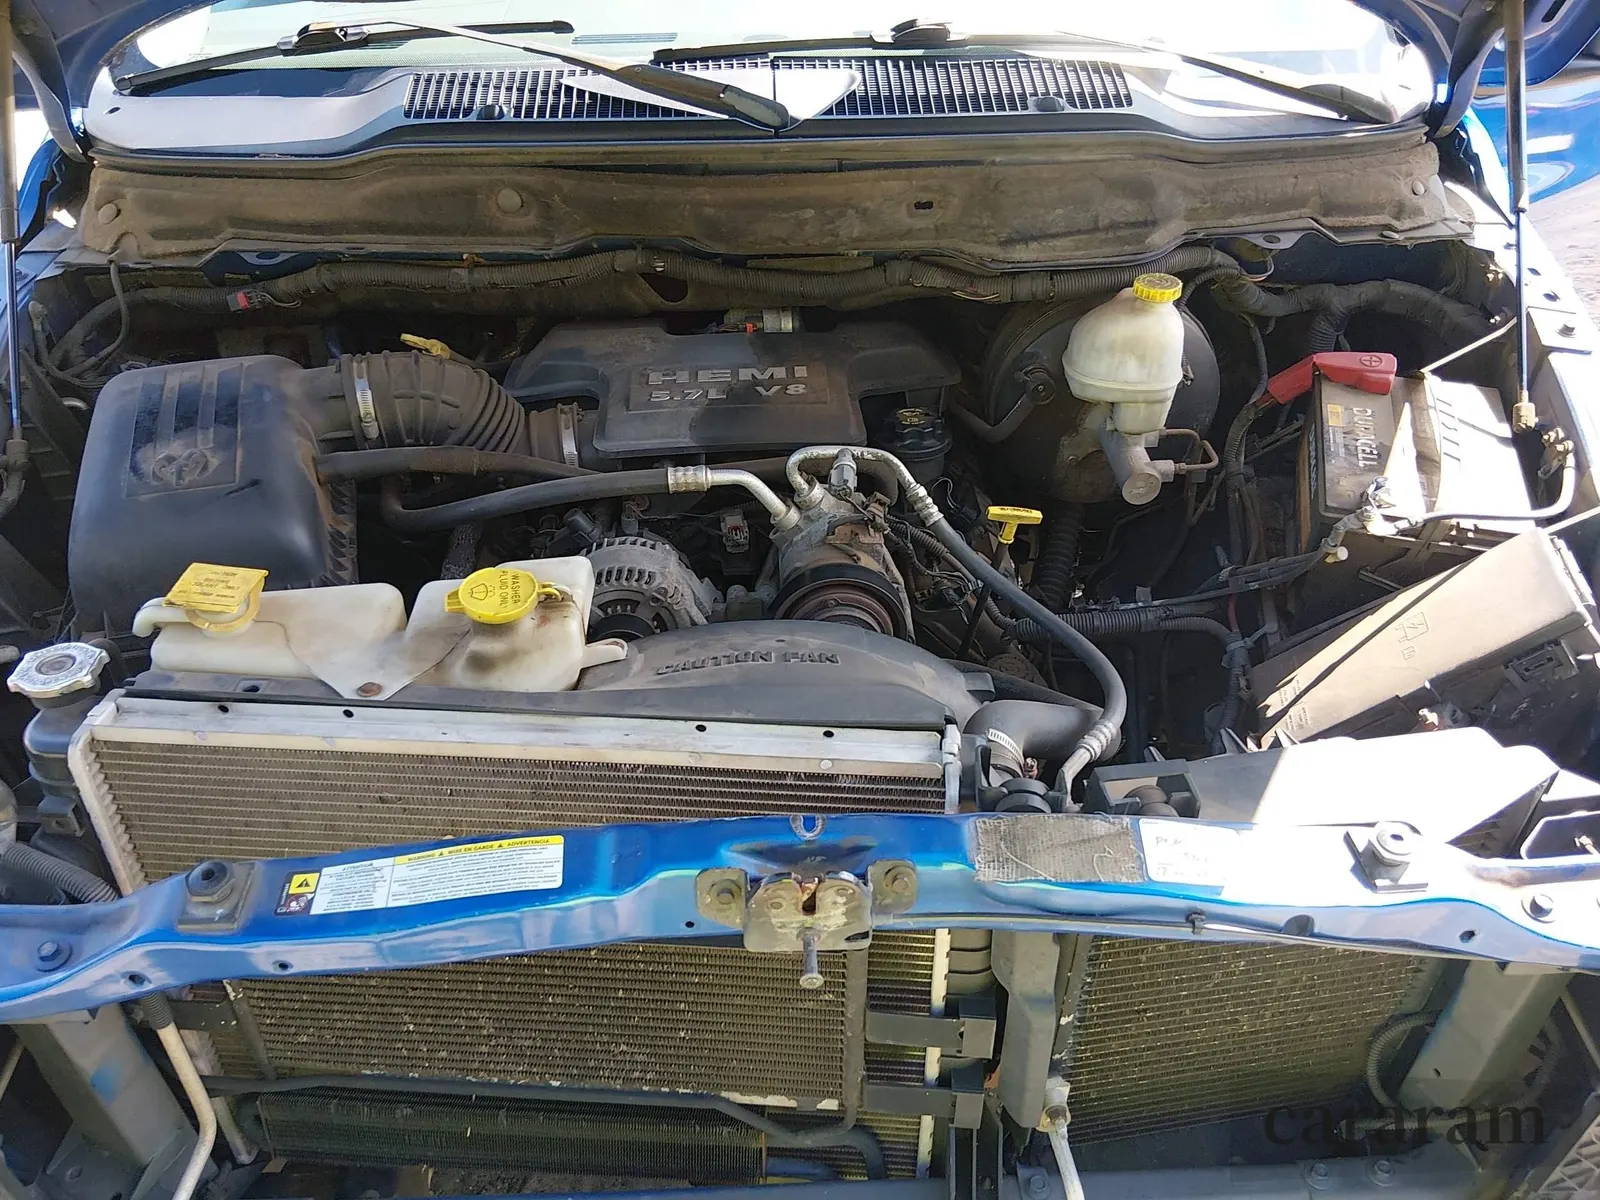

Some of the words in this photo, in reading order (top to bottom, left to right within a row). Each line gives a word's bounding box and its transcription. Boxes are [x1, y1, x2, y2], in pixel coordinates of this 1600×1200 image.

[648, 365, 808, 385] HEMI
[649, 388, 727, 402] 5.7L
[755, 383, 807, 397] V8
[1352, 407, 1379, 468] DURACELL
[499, 570, 509, 593] FLUID
[511, 573, 521, 604] WASHER
[499, 593, 509, 609] ONLY
[656, 650, 775, 676] CAUTION
[782, 651, 842, 665] FAN
[474, 844, 494, 852] GARDE
[507, 838, 550, 847] ADVERTENCIA
